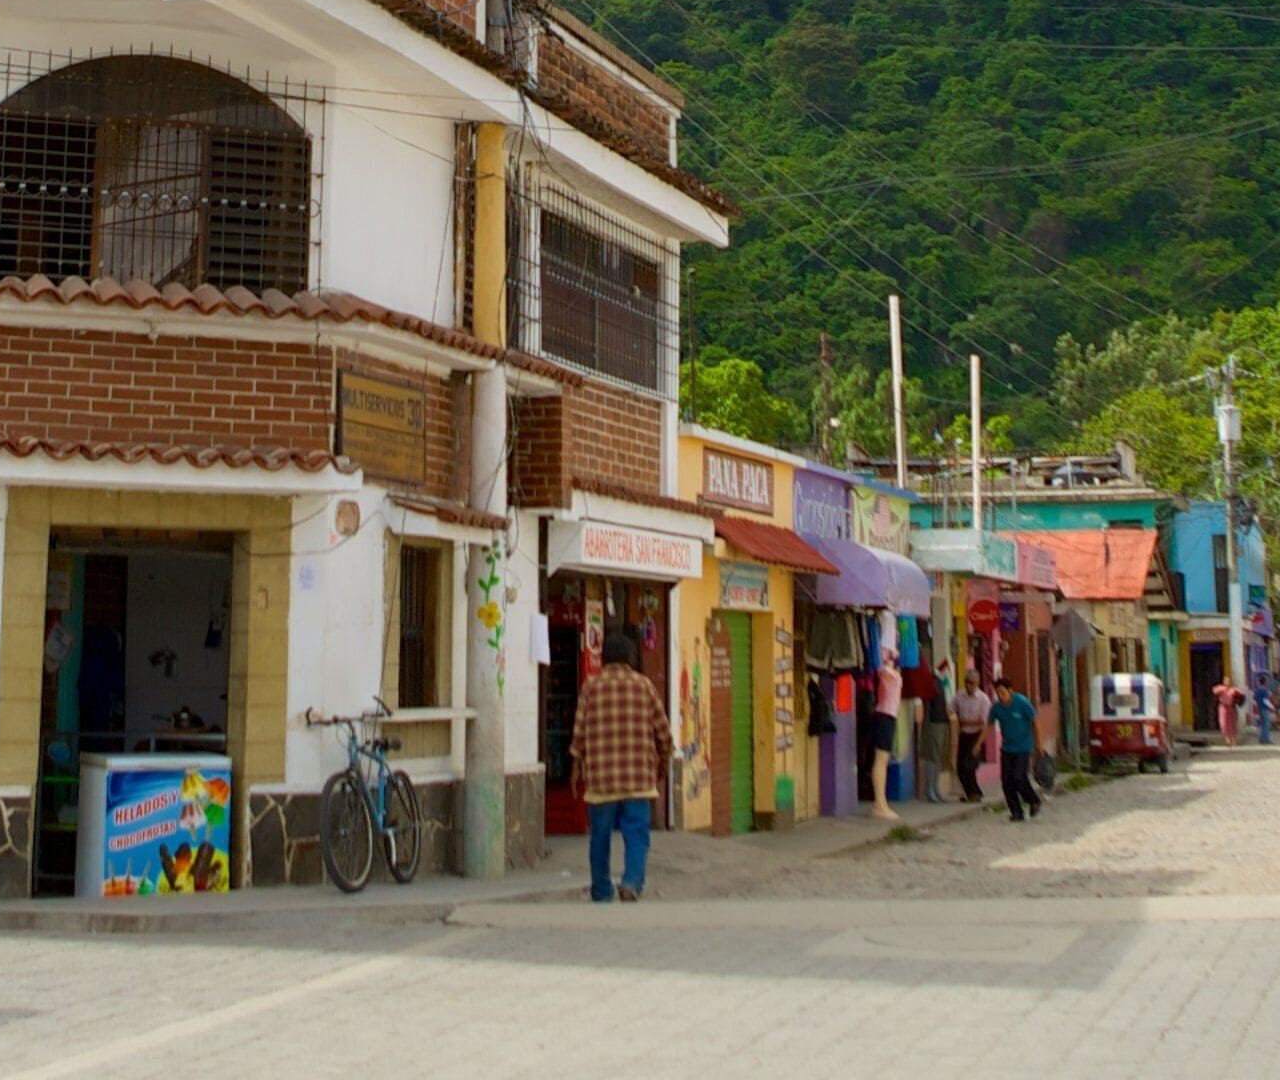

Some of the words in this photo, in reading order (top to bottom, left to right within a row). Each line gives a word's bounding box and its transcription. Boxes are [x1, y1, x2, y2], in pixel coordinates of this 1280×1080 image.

[708, 454, 739, 500] PANA
[741, 461, 770, 505] PACA
[650, 535, 691, 570] FRANCISCO
[114, 793, 168, 824] HELADOS
[170, 789, 178, 805] Y
